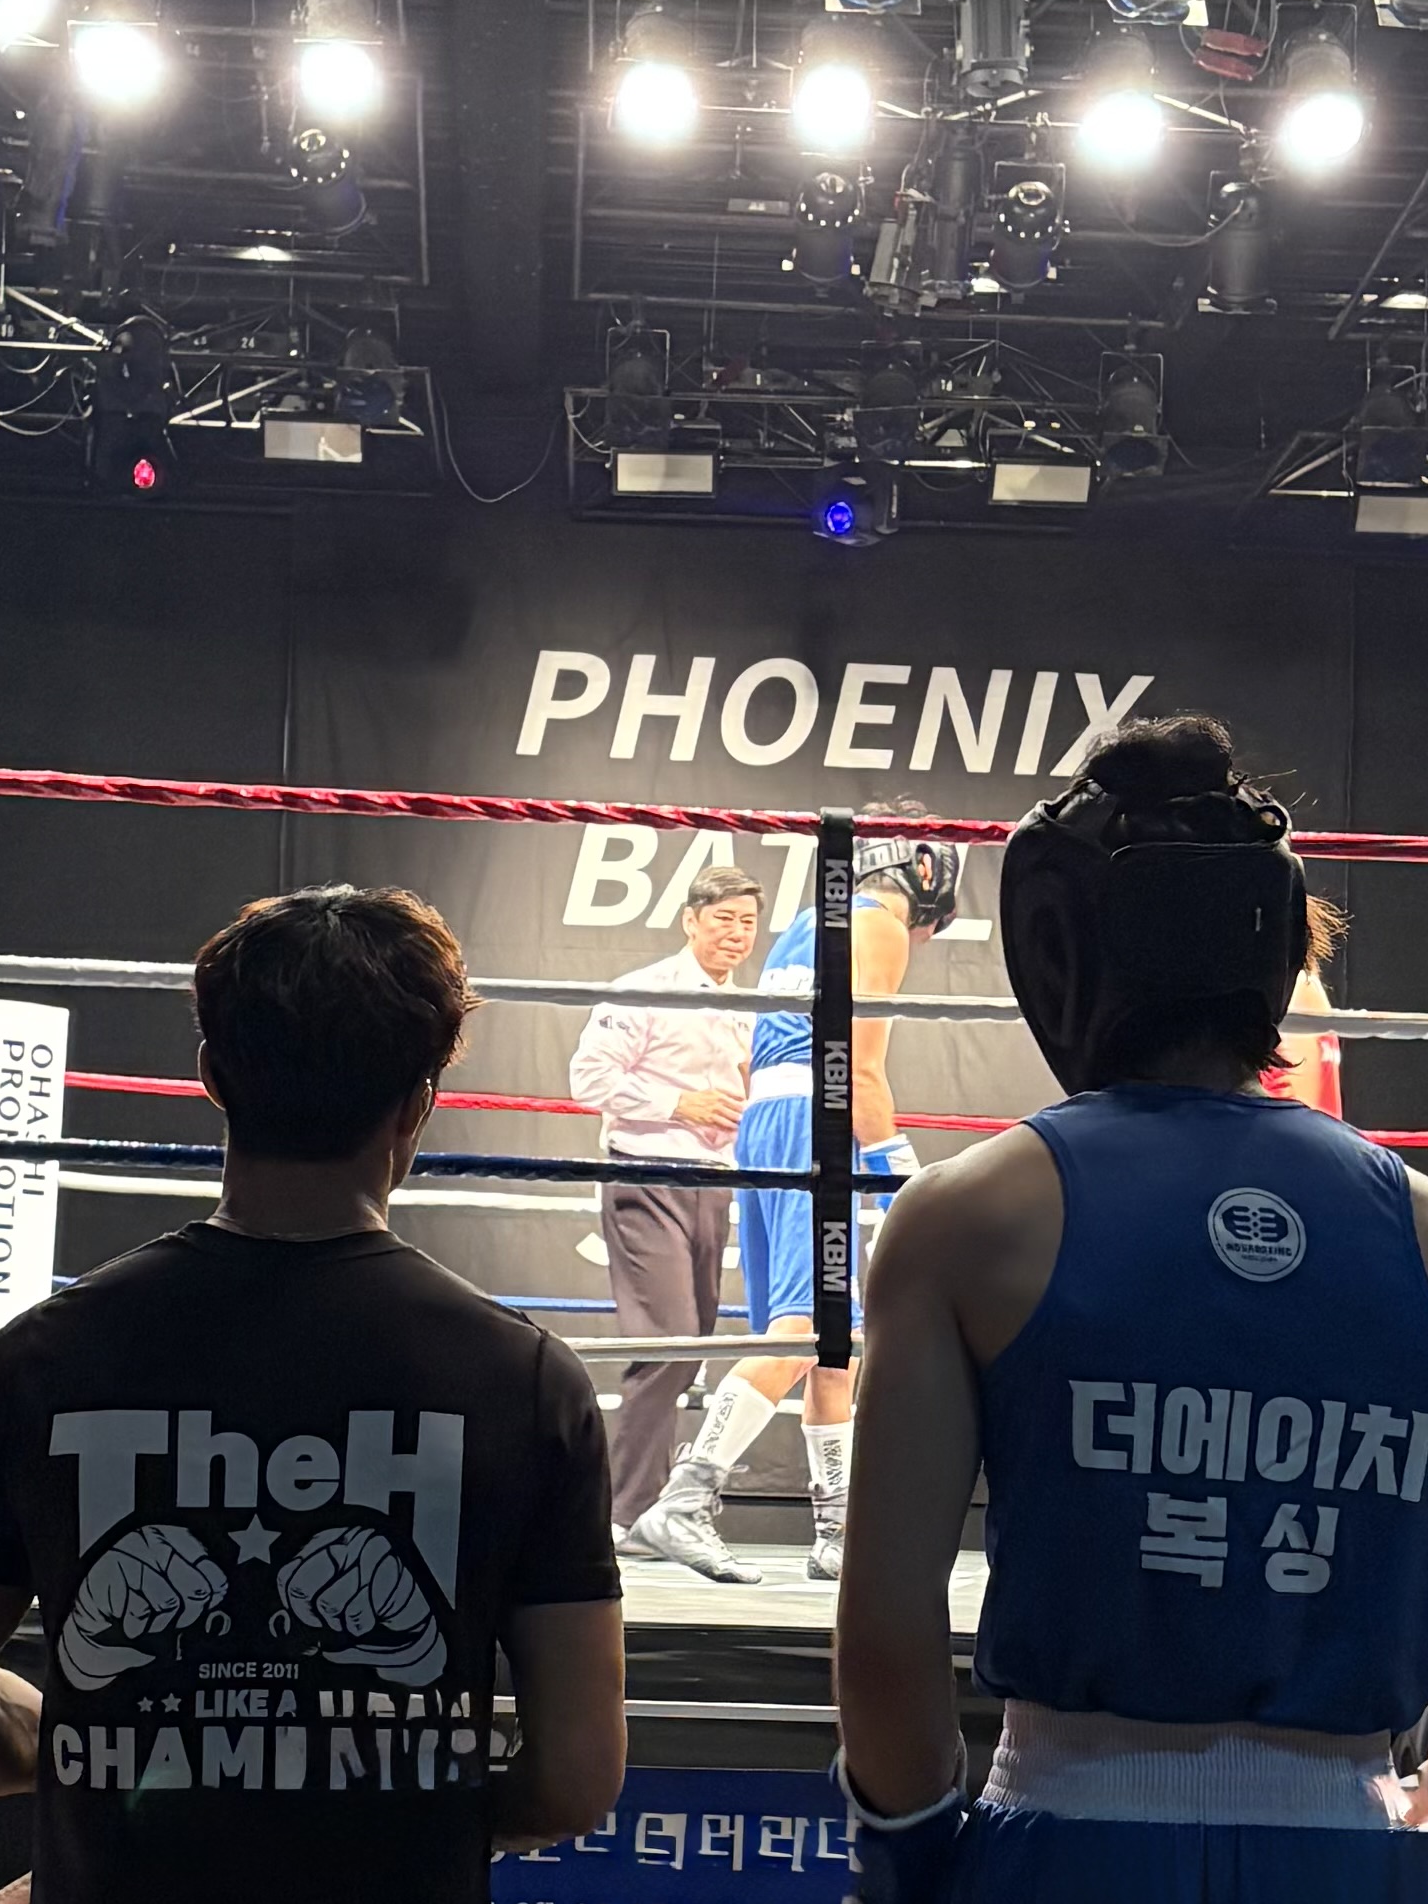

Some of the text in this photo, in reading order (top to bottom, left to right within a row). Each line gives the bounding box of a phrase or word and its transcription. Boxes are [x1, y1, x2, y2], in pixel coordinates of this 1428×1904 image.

[515, 649, 1156, 777] PHOENIX
[824, 859, 849, 929] KBM
[824, 1040, 849, 1110] KBM
[22, 1044, 54, 1196] OHAHI
[822, 1220, 847, 1293] KBM
[48, 1409, 465, 1611] TheH
[1139, 1491, 1340, 1594] 복싱
[195, 1690, 269, 1718] LIKE
[276, 1690, 297, 1718] A
[198, 1662, 300, 1680] SINCE 2011
